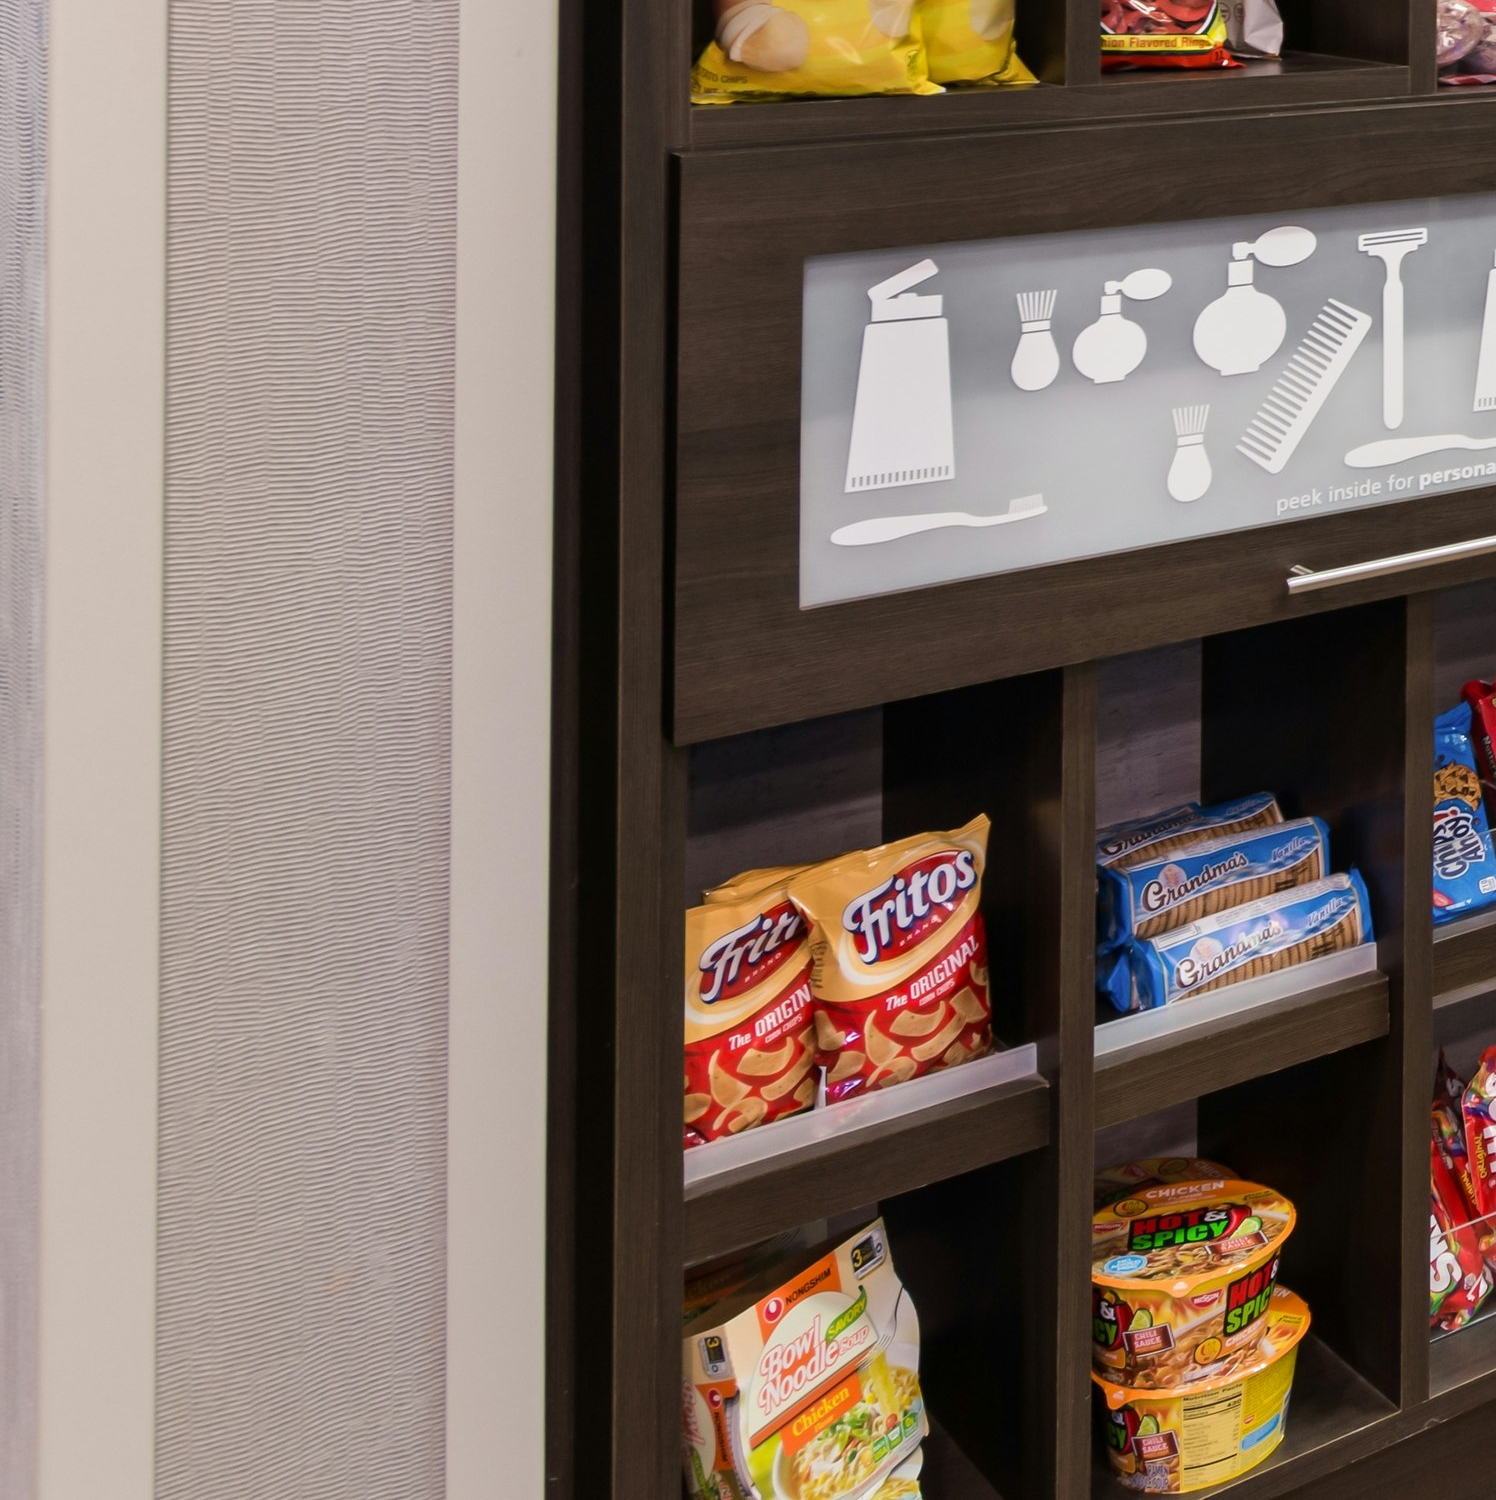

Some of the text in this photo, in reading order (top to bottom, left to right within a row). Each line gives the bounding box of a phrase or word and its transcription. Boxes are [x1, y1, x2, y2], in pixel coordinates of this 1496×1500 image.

[1129, 36, 1212, 48] Flavored Rings
[1276, 489, 1322, 516] peek
[1328, 478, 1381, 503] inside
[1387, 472, 1415, 492] for
[1141, 852, 1248, 913] Grandma's
[842, 850, 976, 964] Fritos
[1175, 897, 1345, 989] Grandma's Vanilla
[886, 935, 980, 1011] The ORIGINAL
[728, 986, 812, 1050] The ORIGIN
[1473, 1133, 1487, 1179] ORIGINAL
[1146, 1180, 1225, 1200] CHICKEN
[1132, 1220, 1229, 1250] SPICY
[1133, 1210, 1228, 1237] HOT &
[852, 1249, 863, 1268] 3
[786, 1266, 832, 1305] NONGSHIM
[1229, 1260, 1272, 1311] HOT
[828, 1300, 866, 1337] SAVORY
[1133, 1329, 1157, 1342] CHILI
[760, 1315, 820, 1380] Bowl
[1133, 1337, 1162, 1349] SAUCE
[758, 1337, 840, 1415] Noodle
[792, 1386, 850, 1437] Chicken
